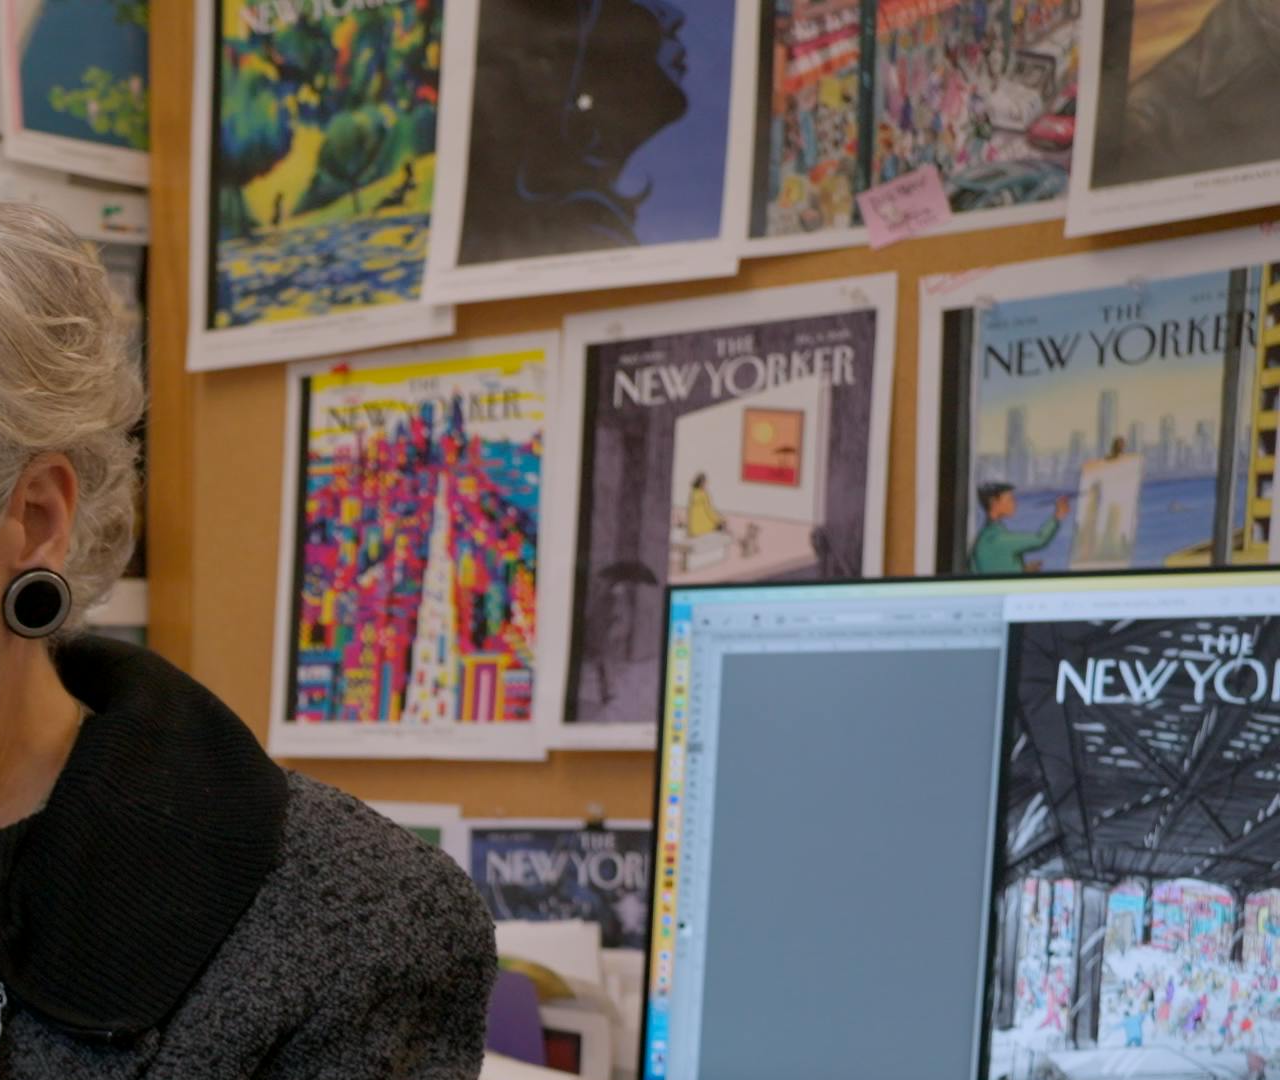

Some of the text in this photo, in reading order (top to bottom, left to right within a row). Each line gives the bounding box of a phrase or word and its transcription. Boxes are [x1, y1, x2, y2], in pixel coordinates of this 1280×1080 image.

[1101, 303, 1144, 323] THE
[983, 310, 1258, 380] NEW YORKER
[612, 344, 856, 408] NEW YORKER
[1198, 632, 1255, 656] THE
[1055, 656, 1180, 706] NEW
[485, 850, 570, 886] NEW
